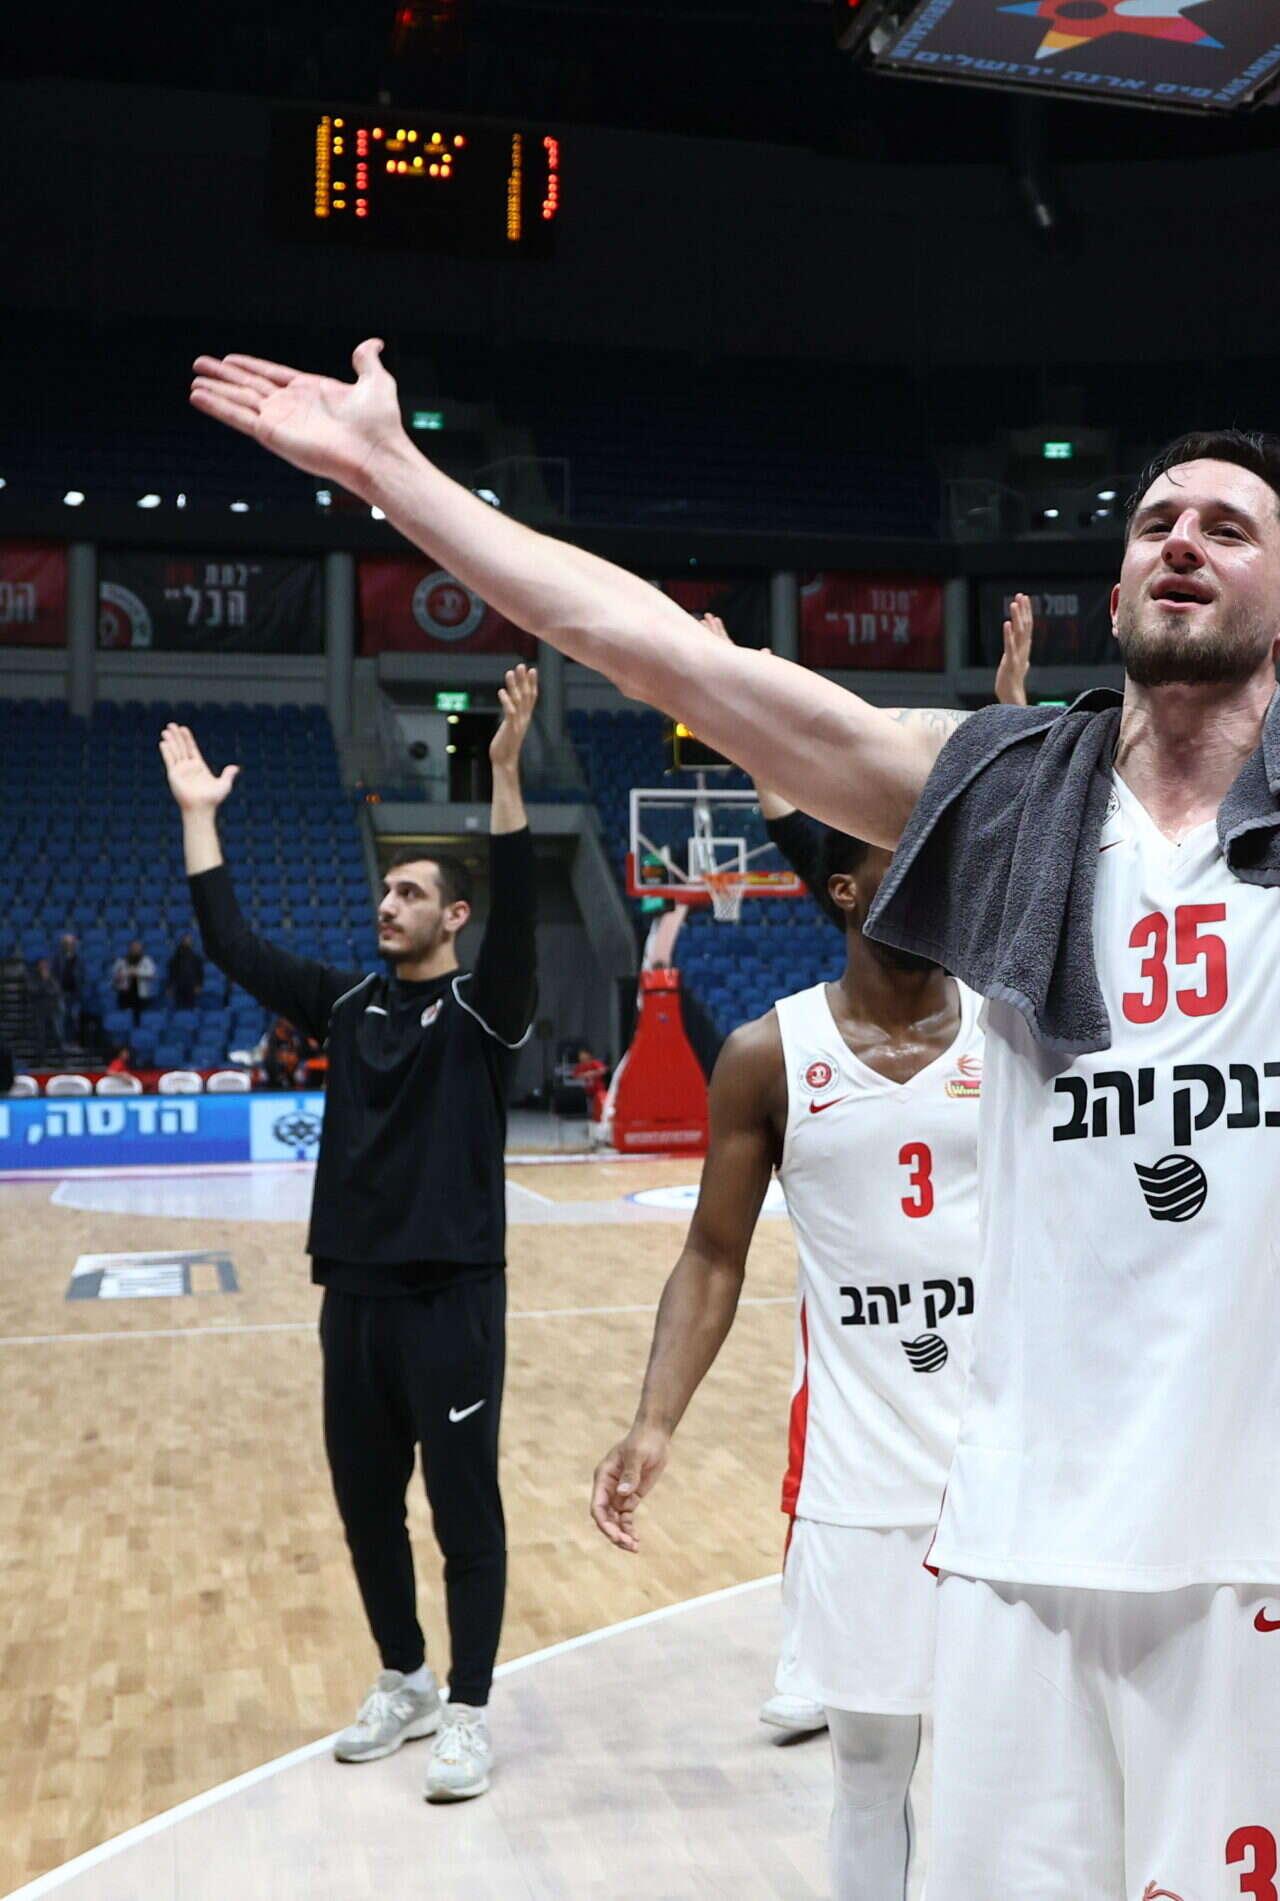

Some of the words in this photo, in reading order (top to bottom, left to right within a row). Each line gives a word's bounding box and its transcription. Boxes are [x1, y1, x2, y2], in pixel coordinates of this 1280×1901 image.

[1122, 903, 1228, 1024] 35
[28, 1101, 199, 1145] הדסה,
[1053, 1067, 1155, 1142] יהב
[898, 1141, 934, 1219] 3
[839, 1284, 912, 1325] יהב
[923, 1276, 975, 1329] נק
